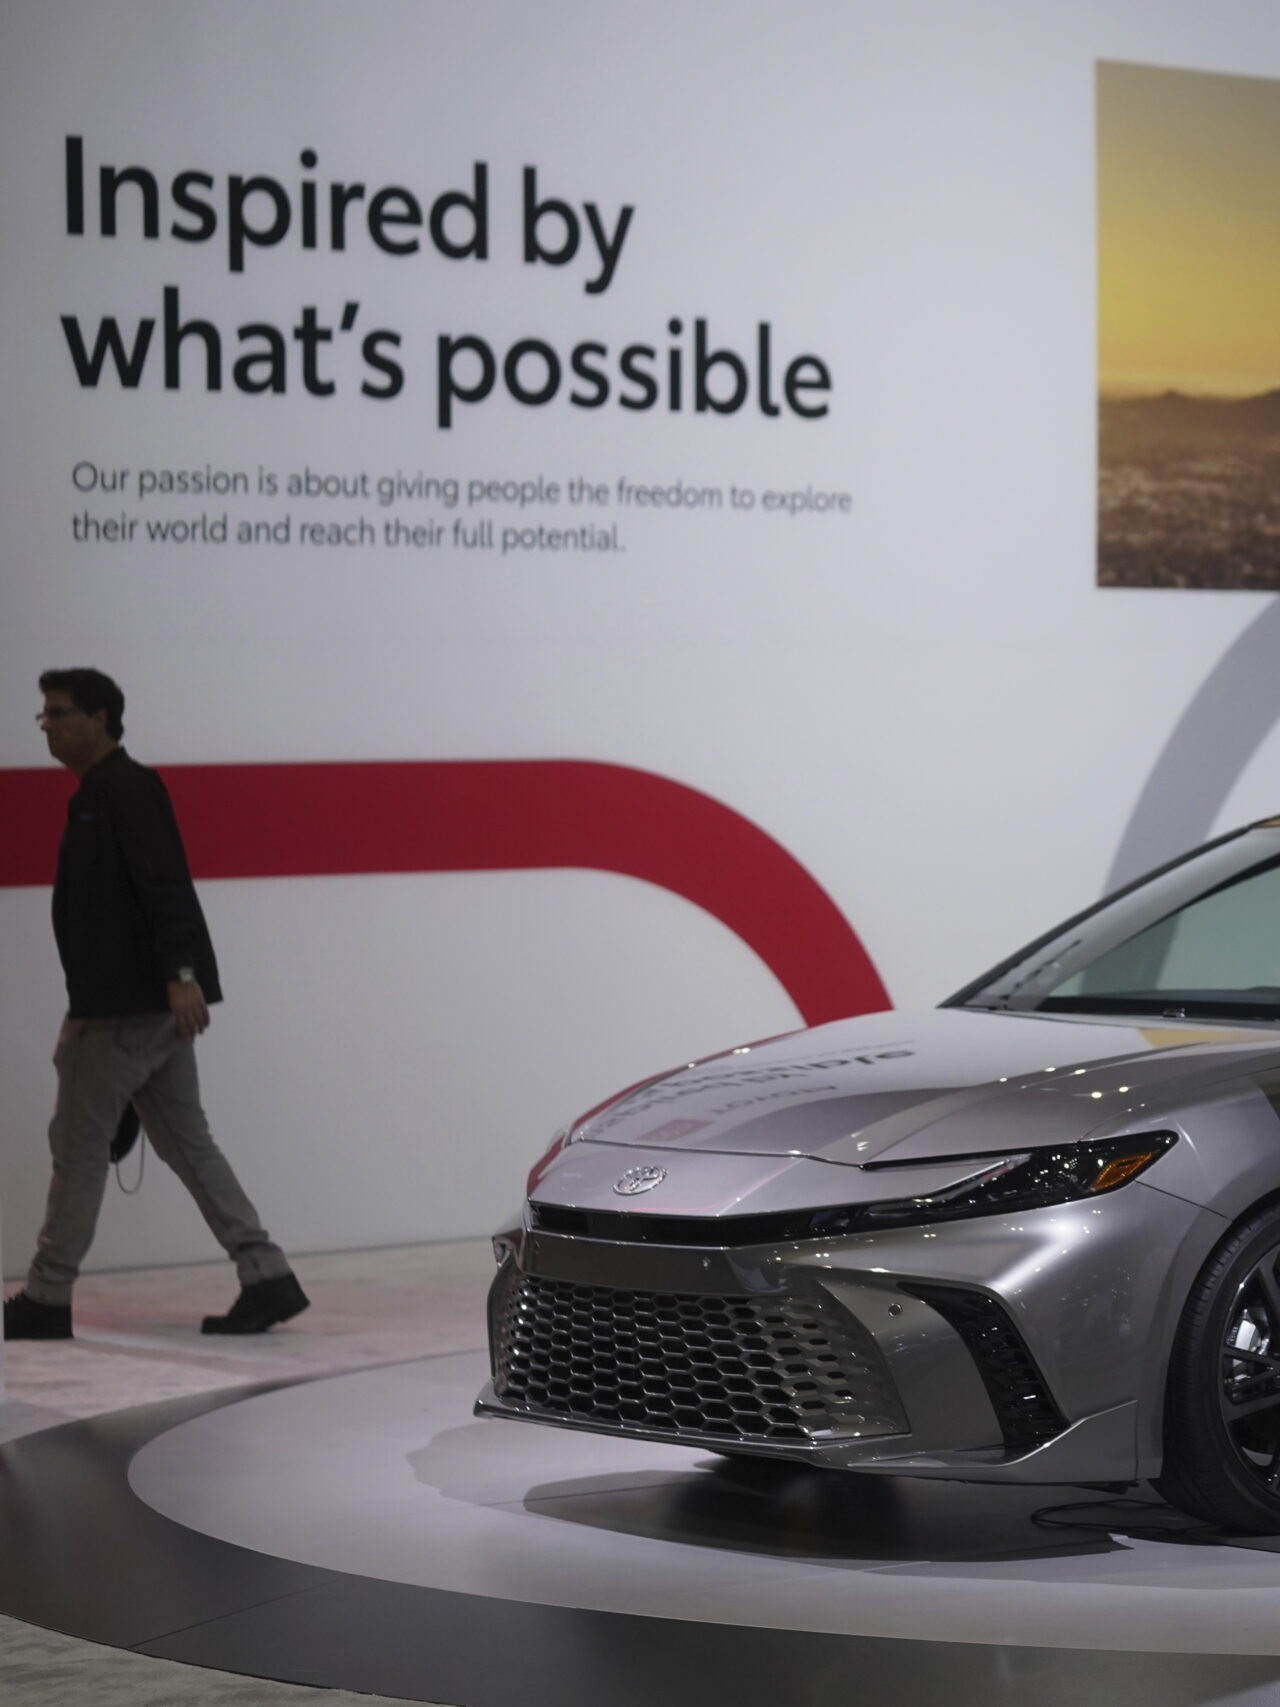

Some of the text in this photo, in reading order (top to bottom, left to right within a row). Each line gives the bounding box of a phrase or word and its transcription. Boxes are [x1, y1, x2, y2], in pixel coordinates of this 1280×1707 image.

[64, 134, 636, 297] Inspired by
[60, 285, 834, 431] what's possible
[71, 510, 627, 556] their world and reach their full potential.
[72, 460, 853, 517] Our passion is about giving people the freedom to explore
